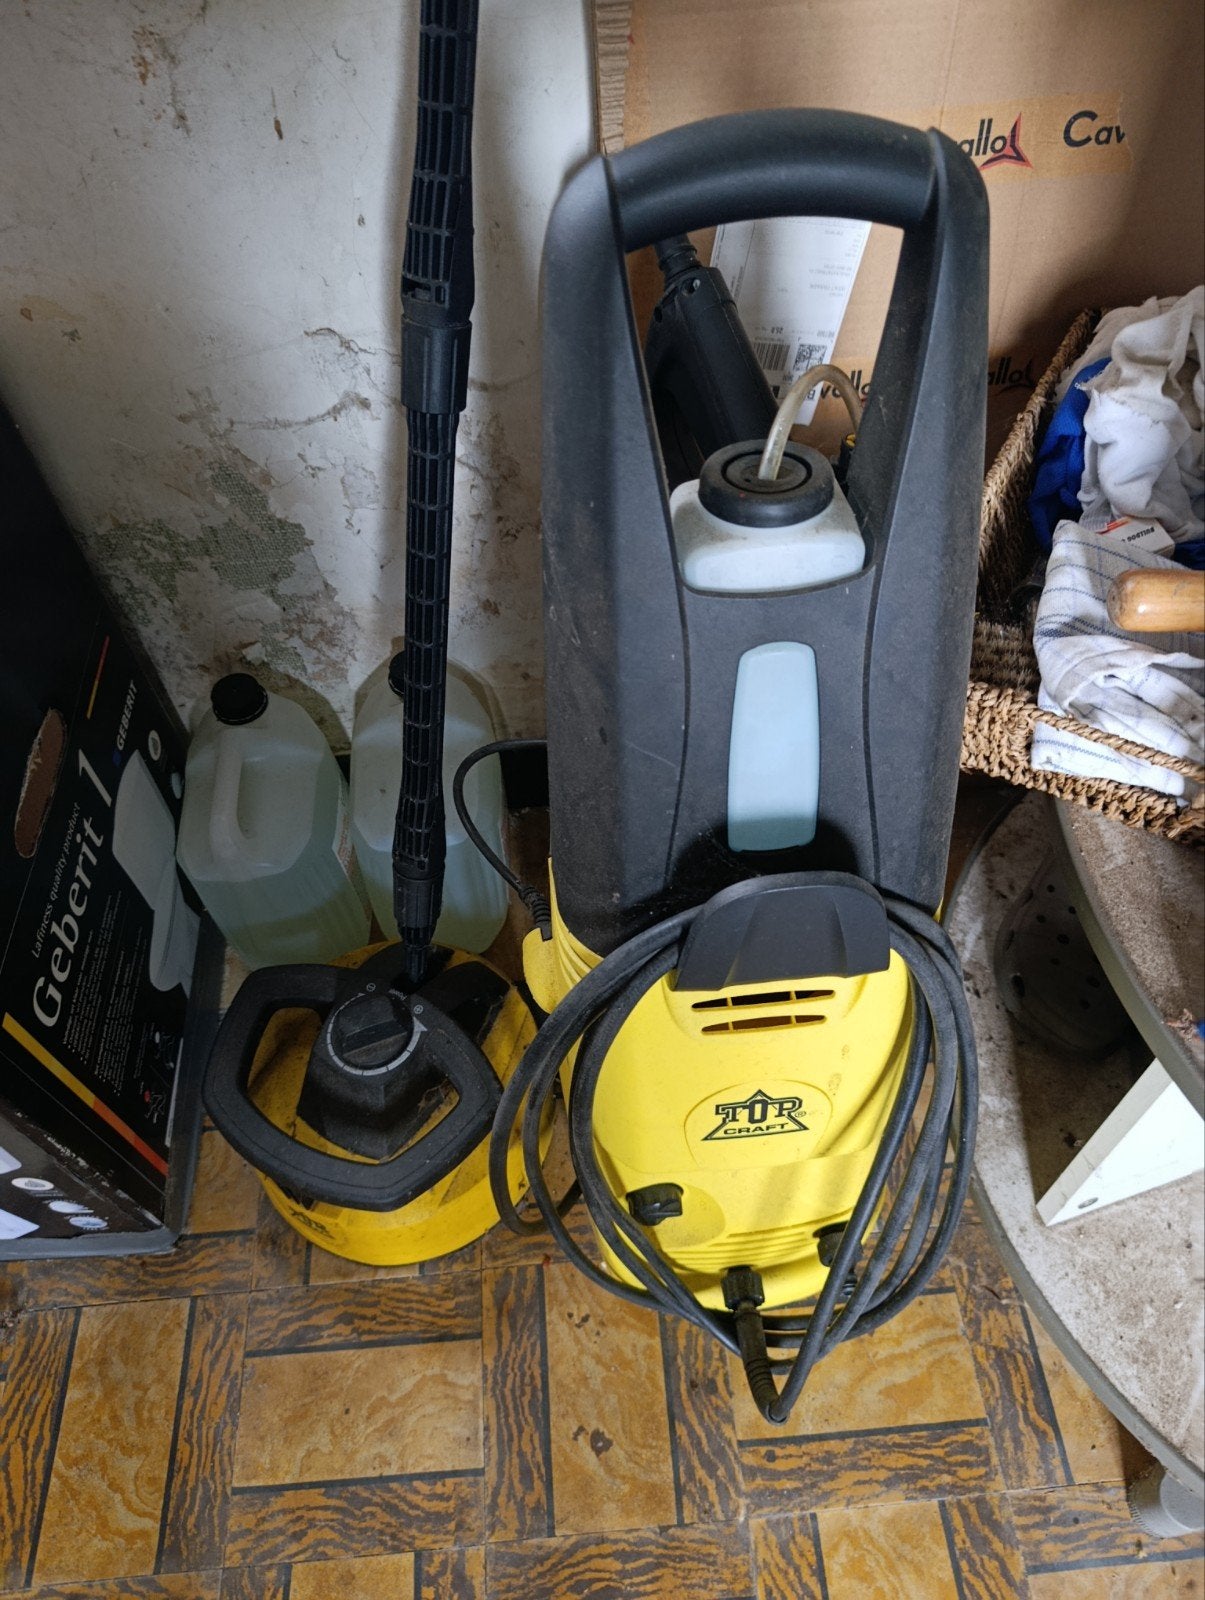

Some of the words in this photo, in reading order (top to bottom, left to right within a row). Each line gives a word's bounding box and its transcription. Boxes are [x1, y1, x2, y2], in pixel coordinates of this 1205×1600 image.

[953, 118, 1007, 157] allo
[1127, 526, 1155, 542] BULLDOG
[117, 680, 138, 751] GEBERIT
[50, 854, 67, 902] quality
[63, 802, 81, 855] product
[33, 816, 104, 1027] Geberit
[79, 748, 112, 808] 1
[715, 1096, 803, 1124] TOP
[724, 1122, 788, 1135] CRAFT
